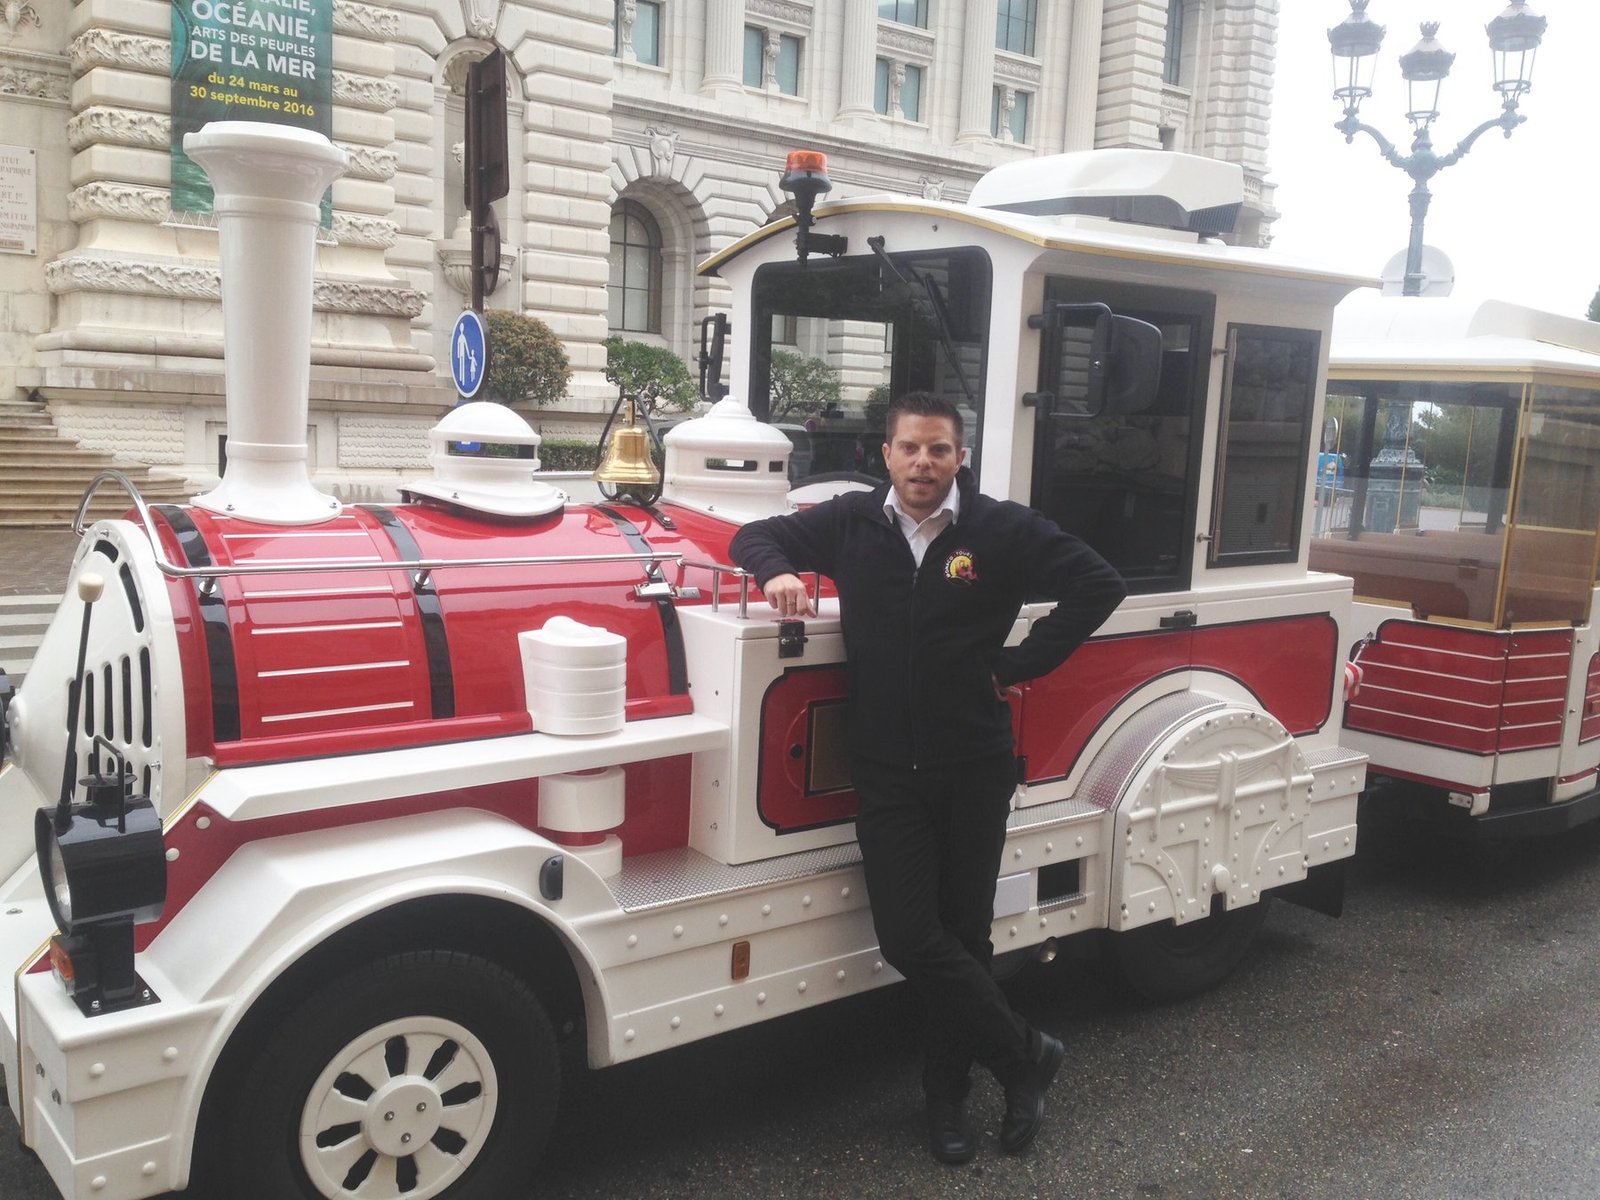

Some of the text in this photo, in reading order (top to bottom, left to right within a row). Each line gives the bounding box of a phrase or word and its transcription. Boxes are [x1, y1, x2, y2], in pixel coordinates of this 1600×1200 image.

[191, 0, 315, 43] OCÉANIE,
[192, 25, 316, 58] ARTS DES PEUPLES
[191, 40, 316, 80] DE LA MER
[190, 86, 315, 116] 30 septembre 2016
[208, 72, 298, 97] du 24 mars au
